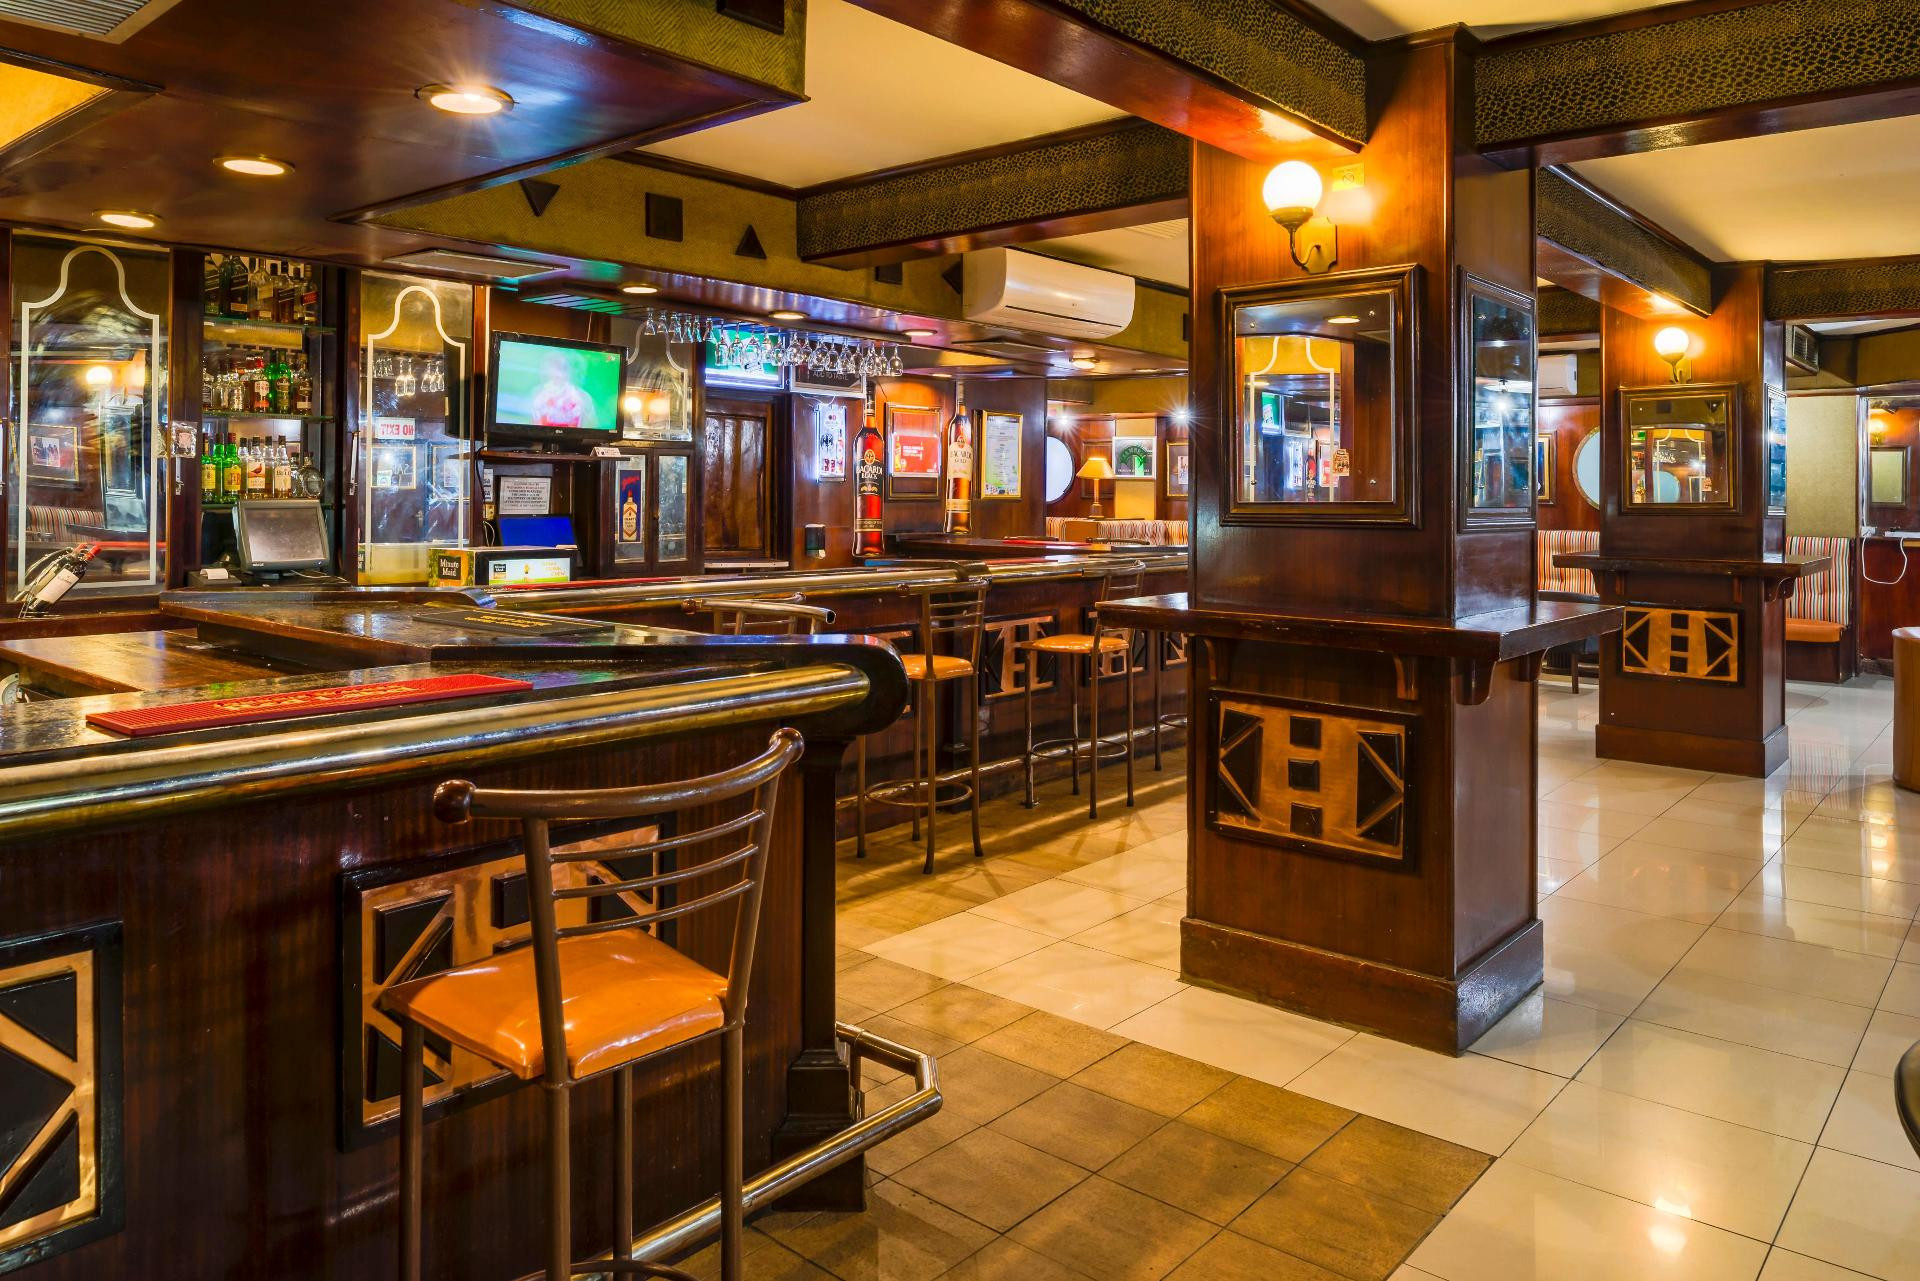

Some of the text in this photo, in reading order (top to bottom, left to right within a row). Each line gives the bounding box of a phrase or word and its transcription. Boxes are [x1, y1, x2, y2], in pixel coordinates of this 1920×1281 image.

[856, 464, 883, 475] BACARDI
[440, 558, 459, 569] Minute
[442, 567, 457, 577] Maid
